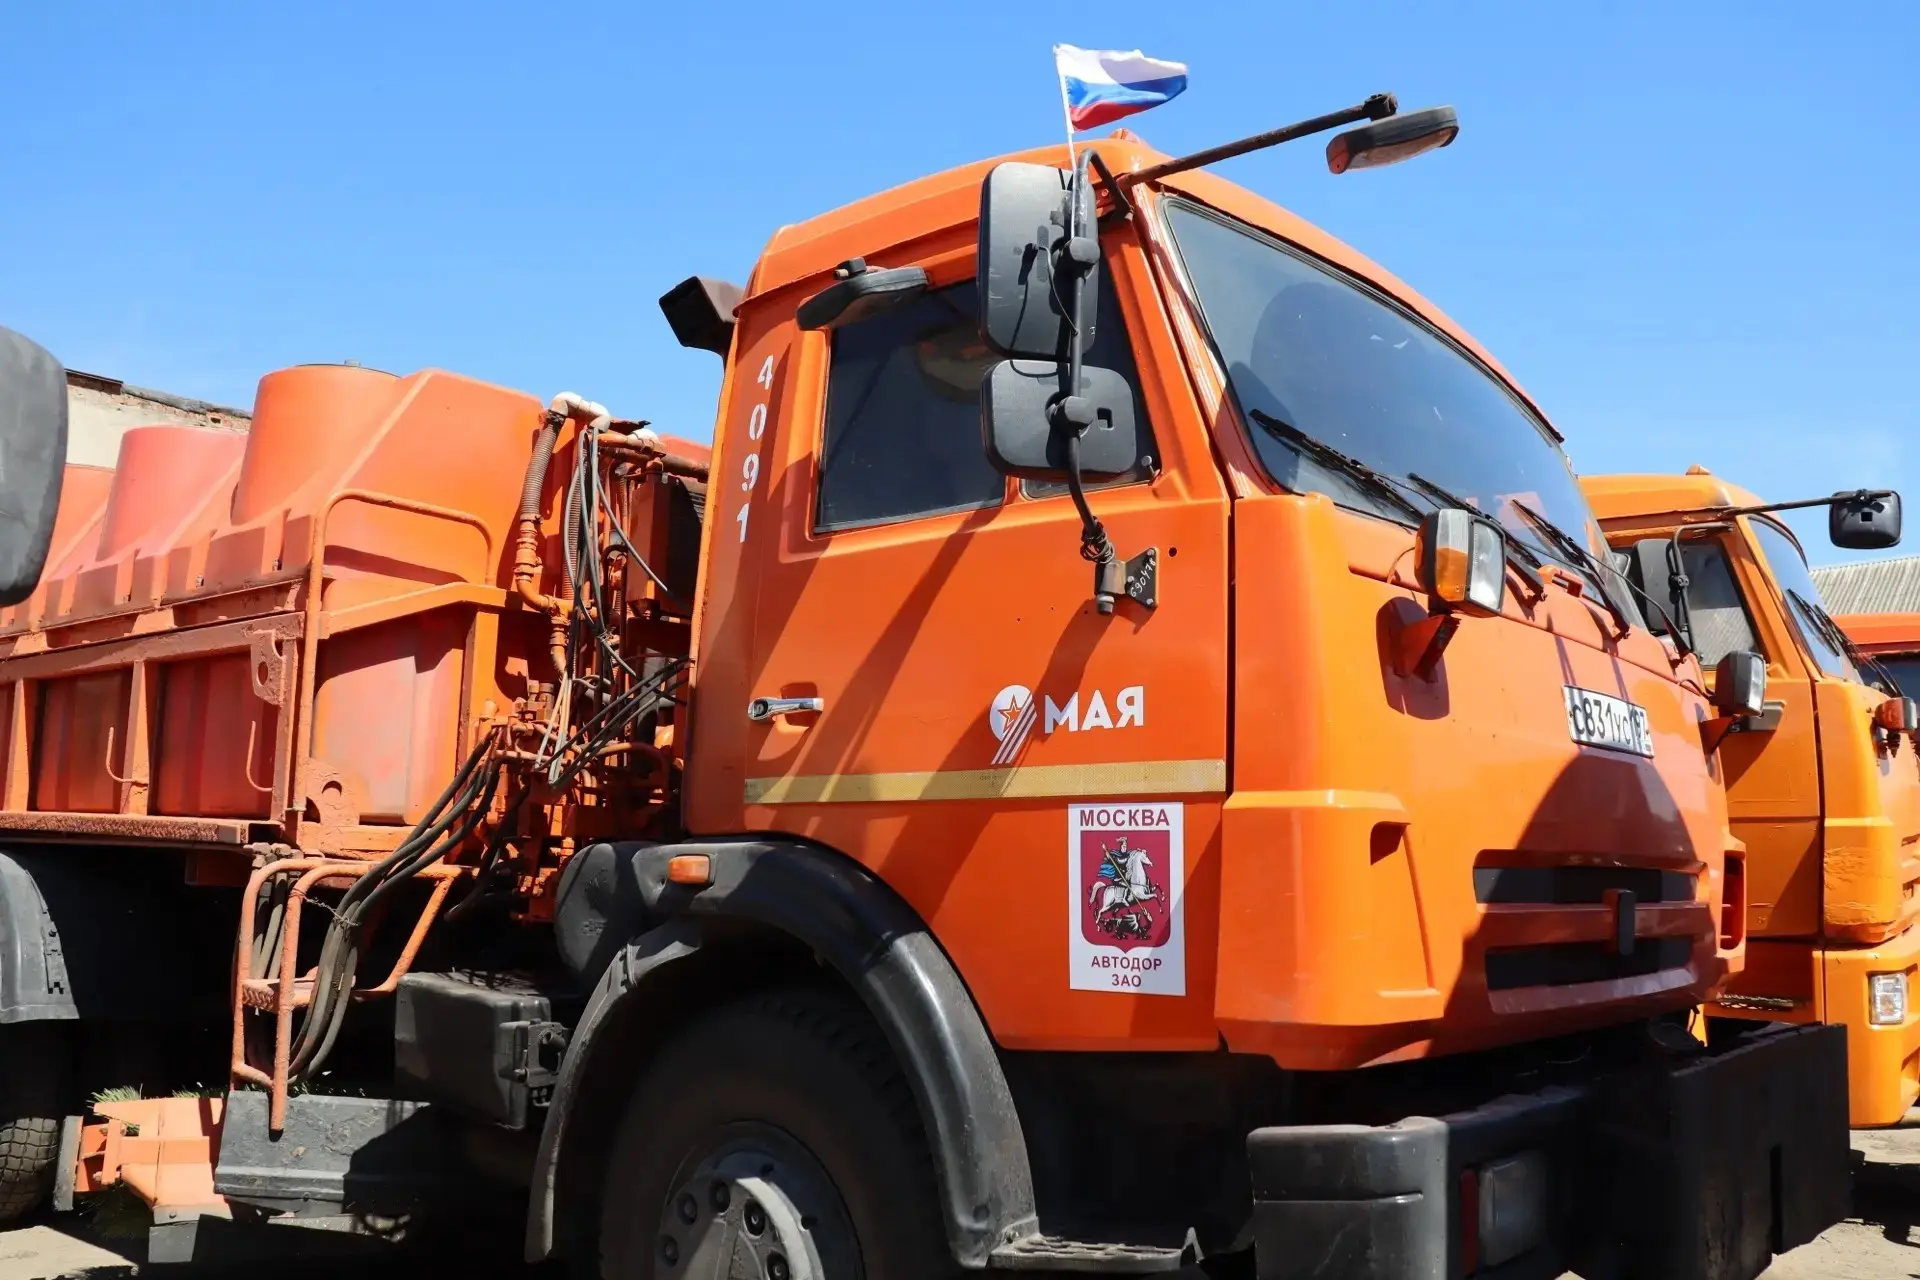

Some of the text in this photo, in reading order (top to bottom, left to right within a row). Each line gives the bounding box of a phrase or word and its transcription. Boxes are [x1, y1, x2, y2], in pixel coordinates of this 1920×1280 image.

[736, 354, 774, 544] 4091
[1044, 685, 1144, 734] МАЯ
[1079, 808, 1170, 828] МОСКВА
[1091, 955, 1163, 972] АВТОДОР
[1111, 973, 1142, 988] ЗАО
